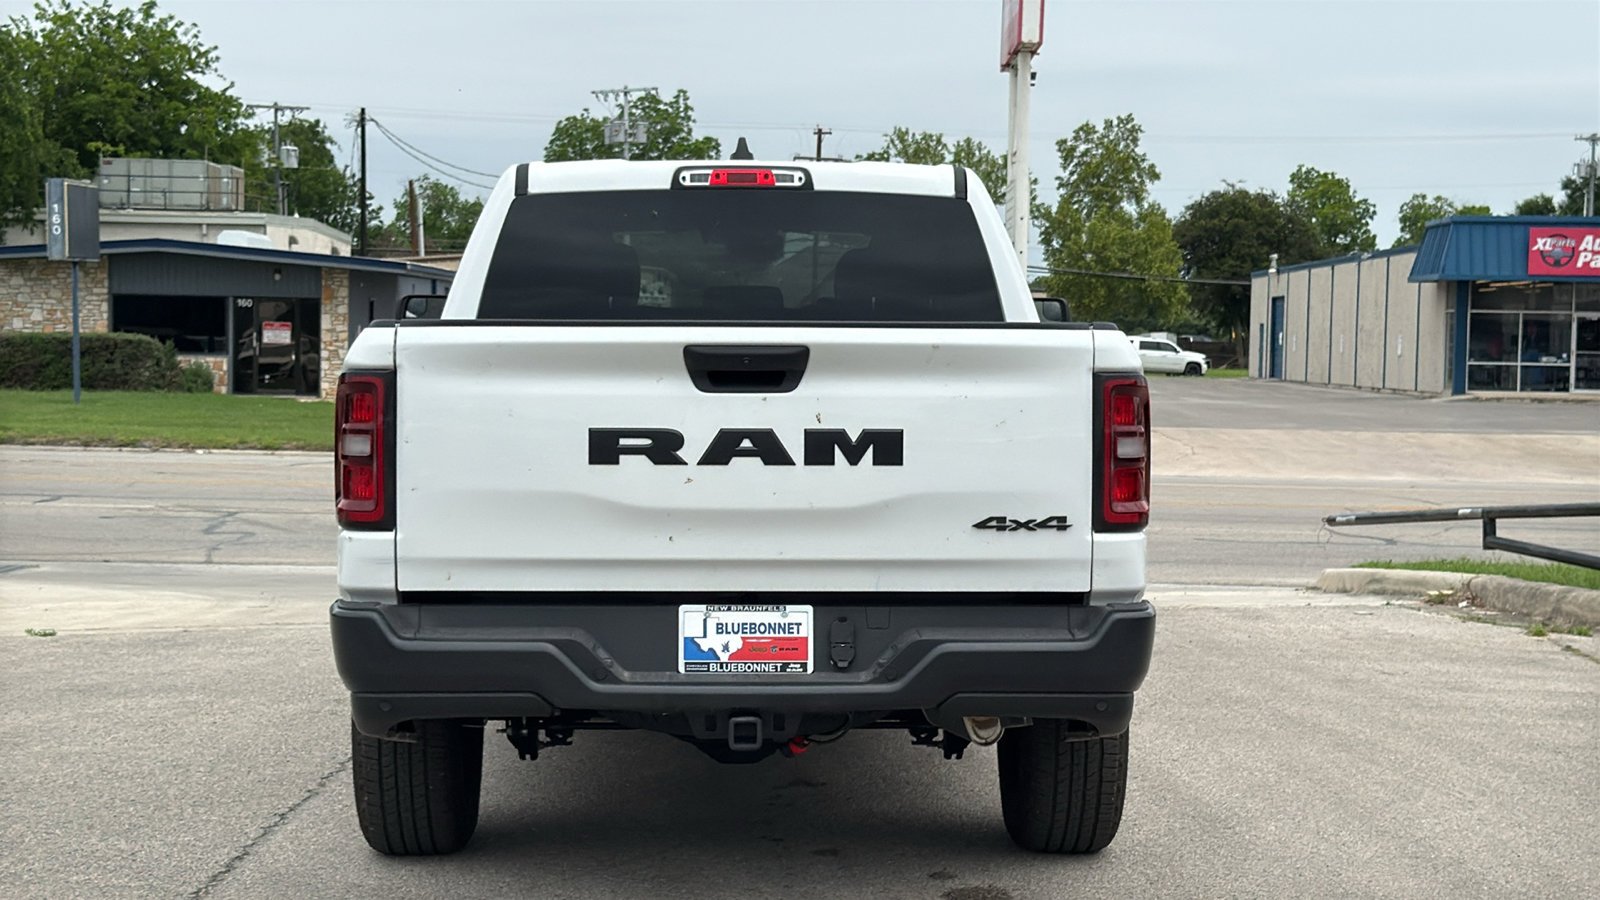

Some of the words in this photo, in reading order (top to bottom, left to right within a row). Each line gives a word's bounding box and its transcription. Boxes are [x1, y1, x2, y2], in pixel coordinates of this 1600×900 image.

[52, 203, 61, 235] 160
[237, 298, 253, 308] 160
[588, 427, 904, 466] RAM
[971, 515, 1073, 532] 4x4
[716, 622, 802, 635] BLUEBONNET
[709, 663, 782, 672] BLUEBONNET
